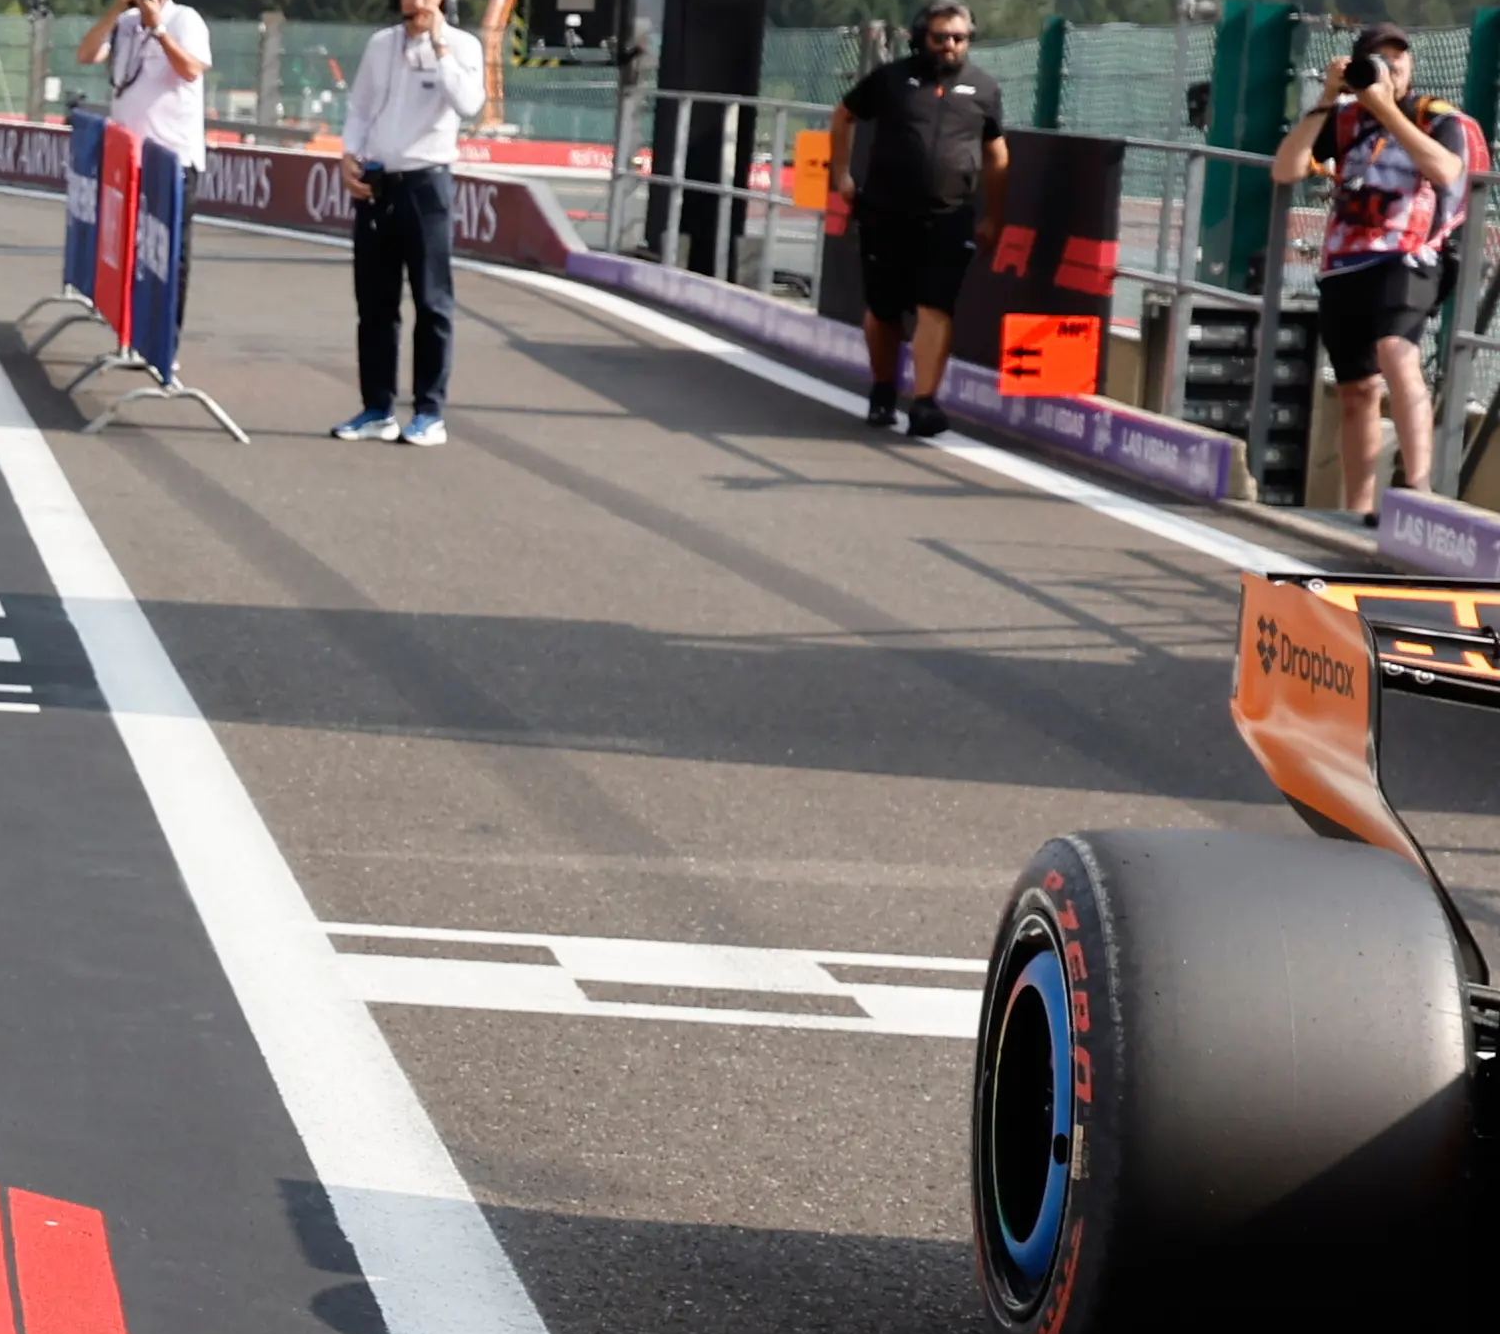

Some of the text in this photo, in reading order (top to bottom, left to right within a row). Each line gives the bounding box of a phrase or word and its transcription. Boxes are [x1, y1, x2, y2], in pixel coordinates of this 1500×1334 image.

[1393, 509, 1478, 567] LAS VEGAS
[1280, 633, 1356, 700] Dropbox
